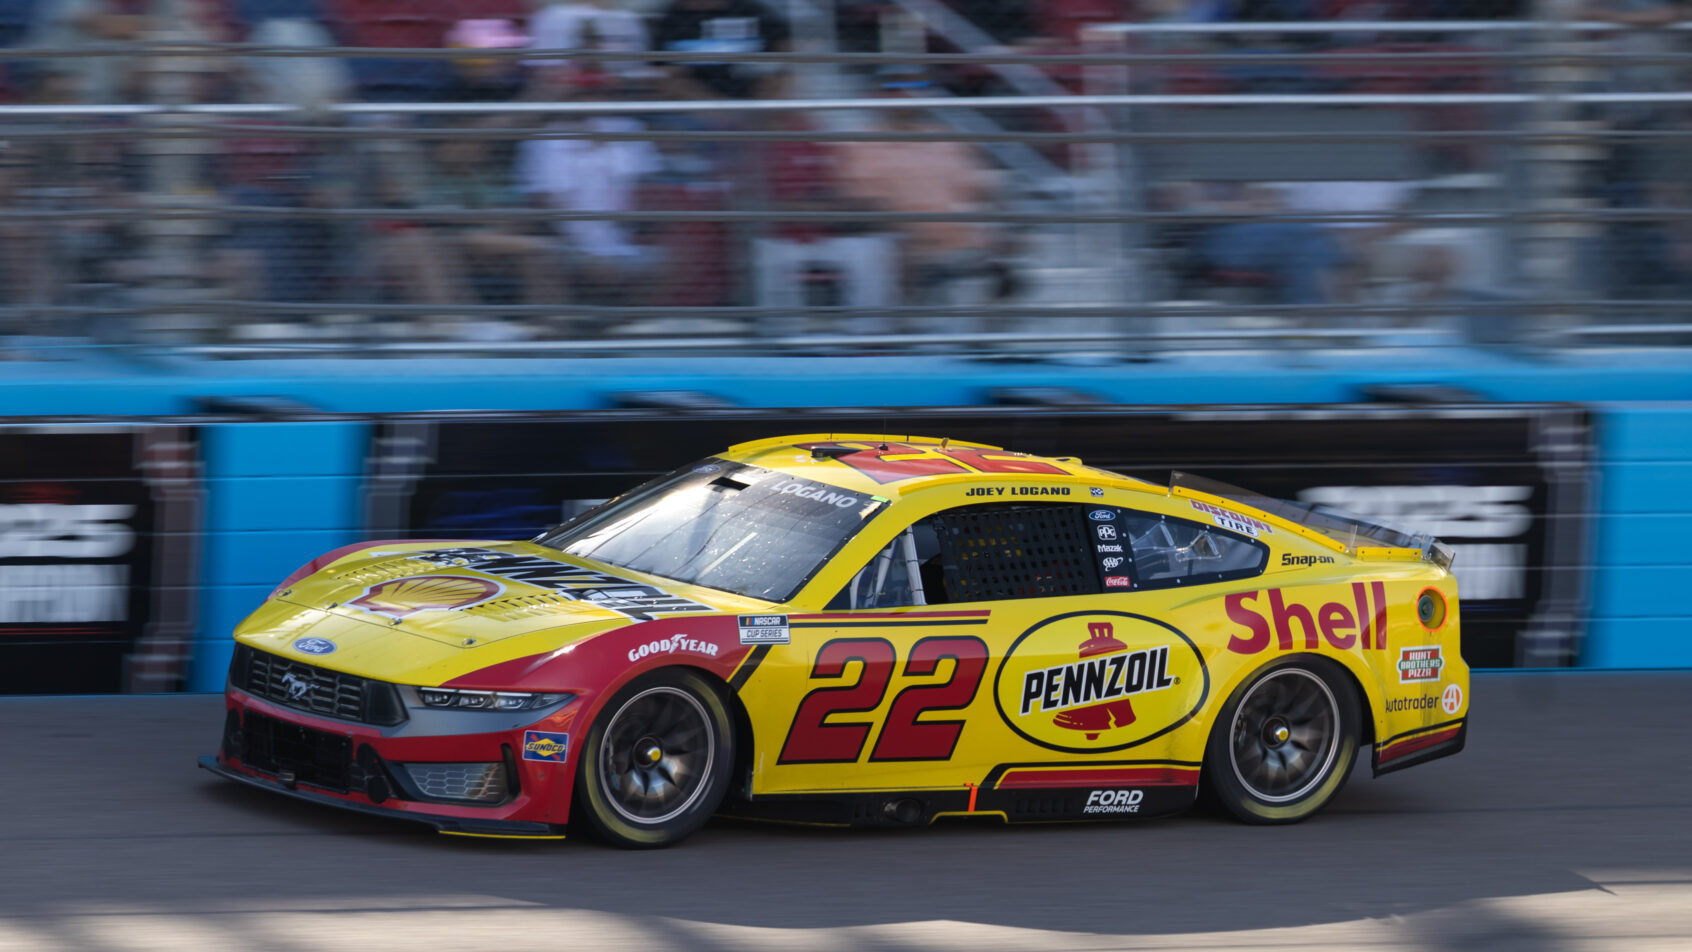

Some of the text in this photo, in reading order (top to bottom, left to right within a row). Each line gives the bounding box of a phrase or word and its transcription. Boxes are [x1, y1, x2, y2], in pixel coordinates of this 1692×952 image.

[770, 480, 858, 509] LOGANO
[966, 487, 1071, 497] JOEY LOGANO
[1189, 500, 1274, 534] DISCOUNT
[1218, 517, 1255, 535] TIRE
[1097, 544, 1122, 552] Mazak
[1281, 553, 1335, 567] Snap-on
[754, 616, 781, 625] NASCAR
[1225, 581, 1387, 655] Shell
[746, 629, 783, 637] CUP SERIES
[628, 634, 719, 662] GOODYEAR
[1409, 651, 1432, 660] HUNT
[1400, 659, 1441, 670] BROTHERS
[1408, 668, 1432, 678] PIZZA
[1019, 645, 1175, 716] PENNZOIL
[776, 635, 990, 766] 22
[1385, 694, 1440, 713] Autotrader
[527, 743, 566, 754] SUNOCO
[1086, 790, 1144, 806] FORD
[1083, 805, 1140, 814] PERFORMANCE
